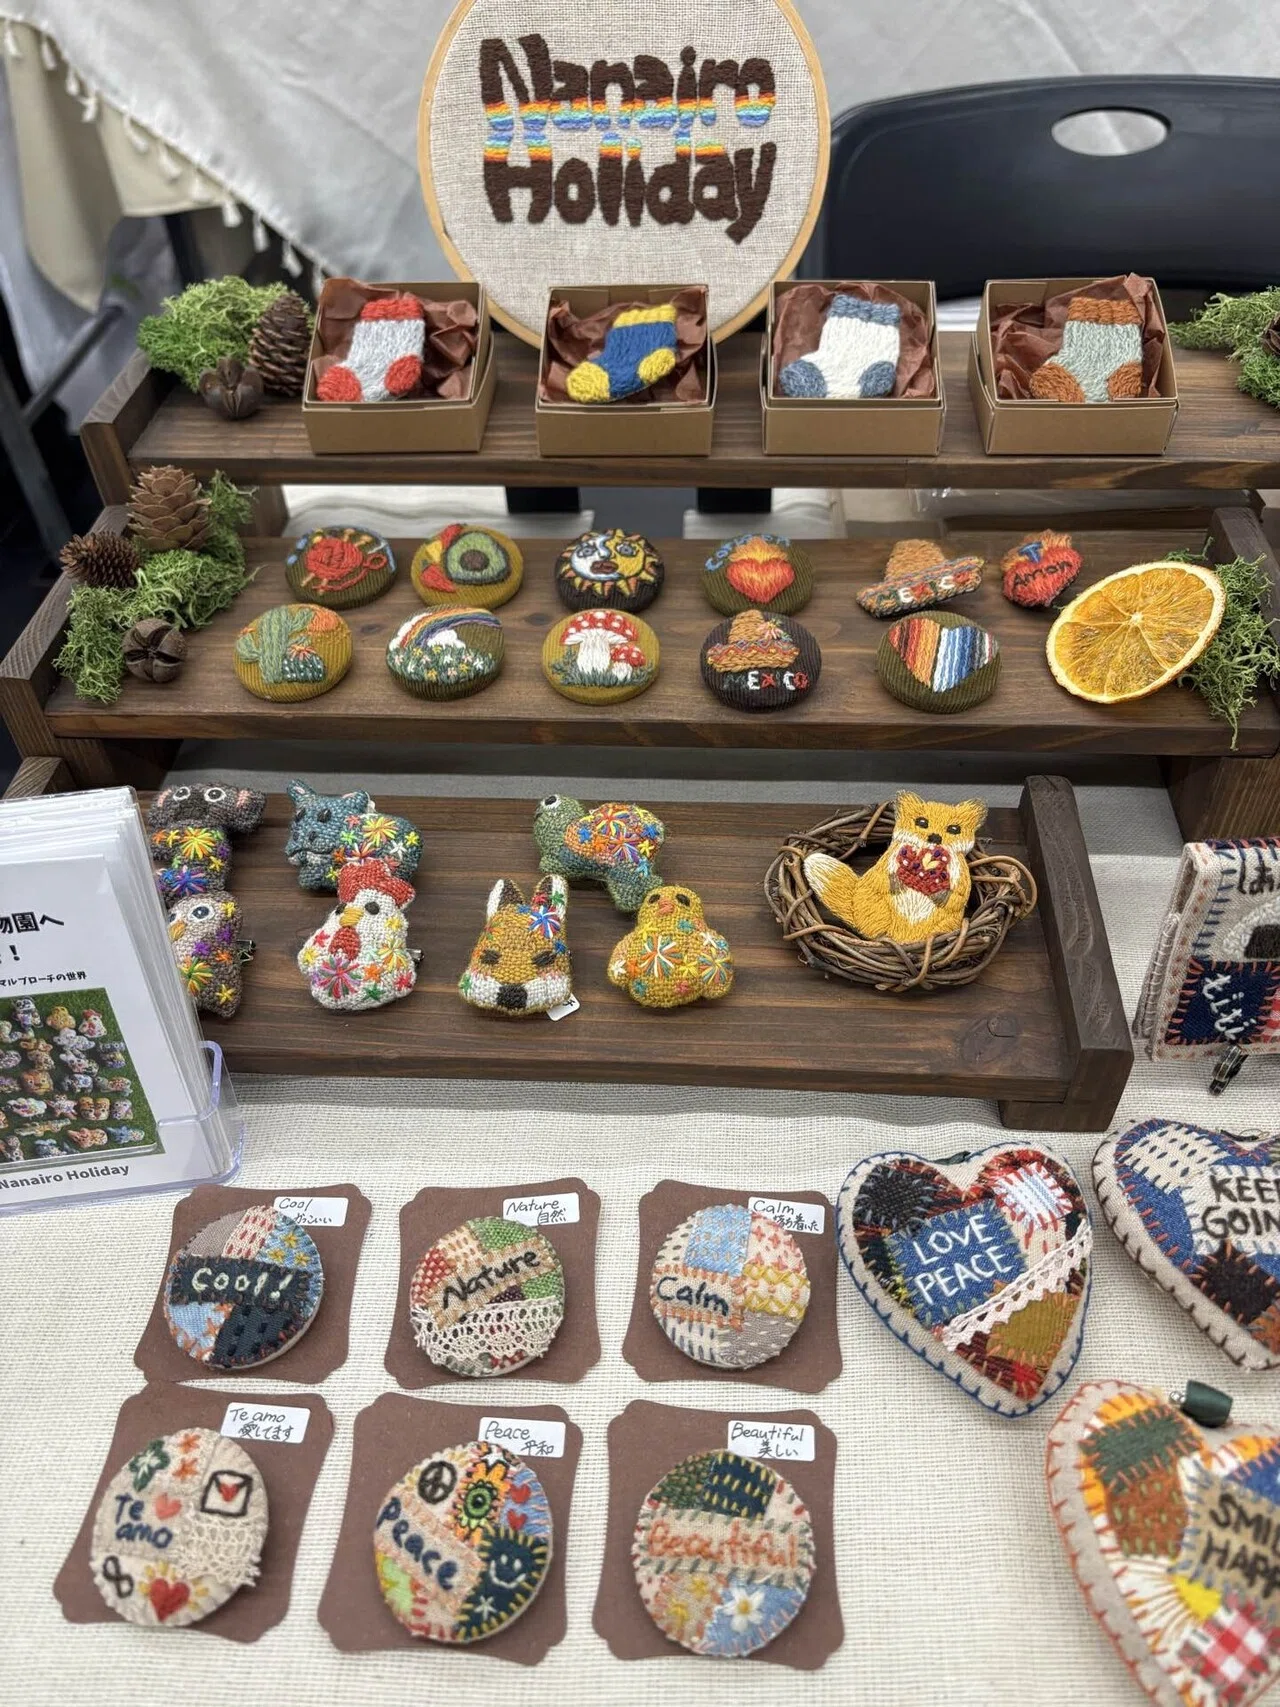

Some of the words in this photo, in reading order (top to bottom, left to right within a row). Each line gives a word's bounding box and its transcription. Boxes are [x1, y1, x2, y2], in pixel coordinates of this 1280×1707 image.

[479, 34, 777, 131] Nanairo
[483, 129, 777, 245] Holiday
[723, 670, 809, 691] MEXICO
[0, 1174, 64, 1190] Nanairo
[66, 1165, 129, 1181] Holiday
[279, 1198, 313, 1212] Cool
[506, 1198, 560, 1216] Nature
[537, 1208, 567, 1225] 自然
[753, 1199, 795, 1215] Calm
[913, 1214, 992, 1265] LOVE
[191, 1267, 293, 1299] Cool!
[443, 1250, 540, 1309] Nature
[914, 1246, 1012, 1306] PEACE
[656, 1276, 729, 1317] Calm
[237, 1422, 295, 1441] 愛してます
[485, 1420, 530, 1440] Peace
[731, 1422, 804, 1442] Beautiful
[520, 1440, 555, 1456] 平和
[758, 1440, 799, 1458] 美しい
[115, 1494, 145, 1524] Te
[115, 1524, 173, 1549] amo
[376, 1496, 458, 1590] Peace
